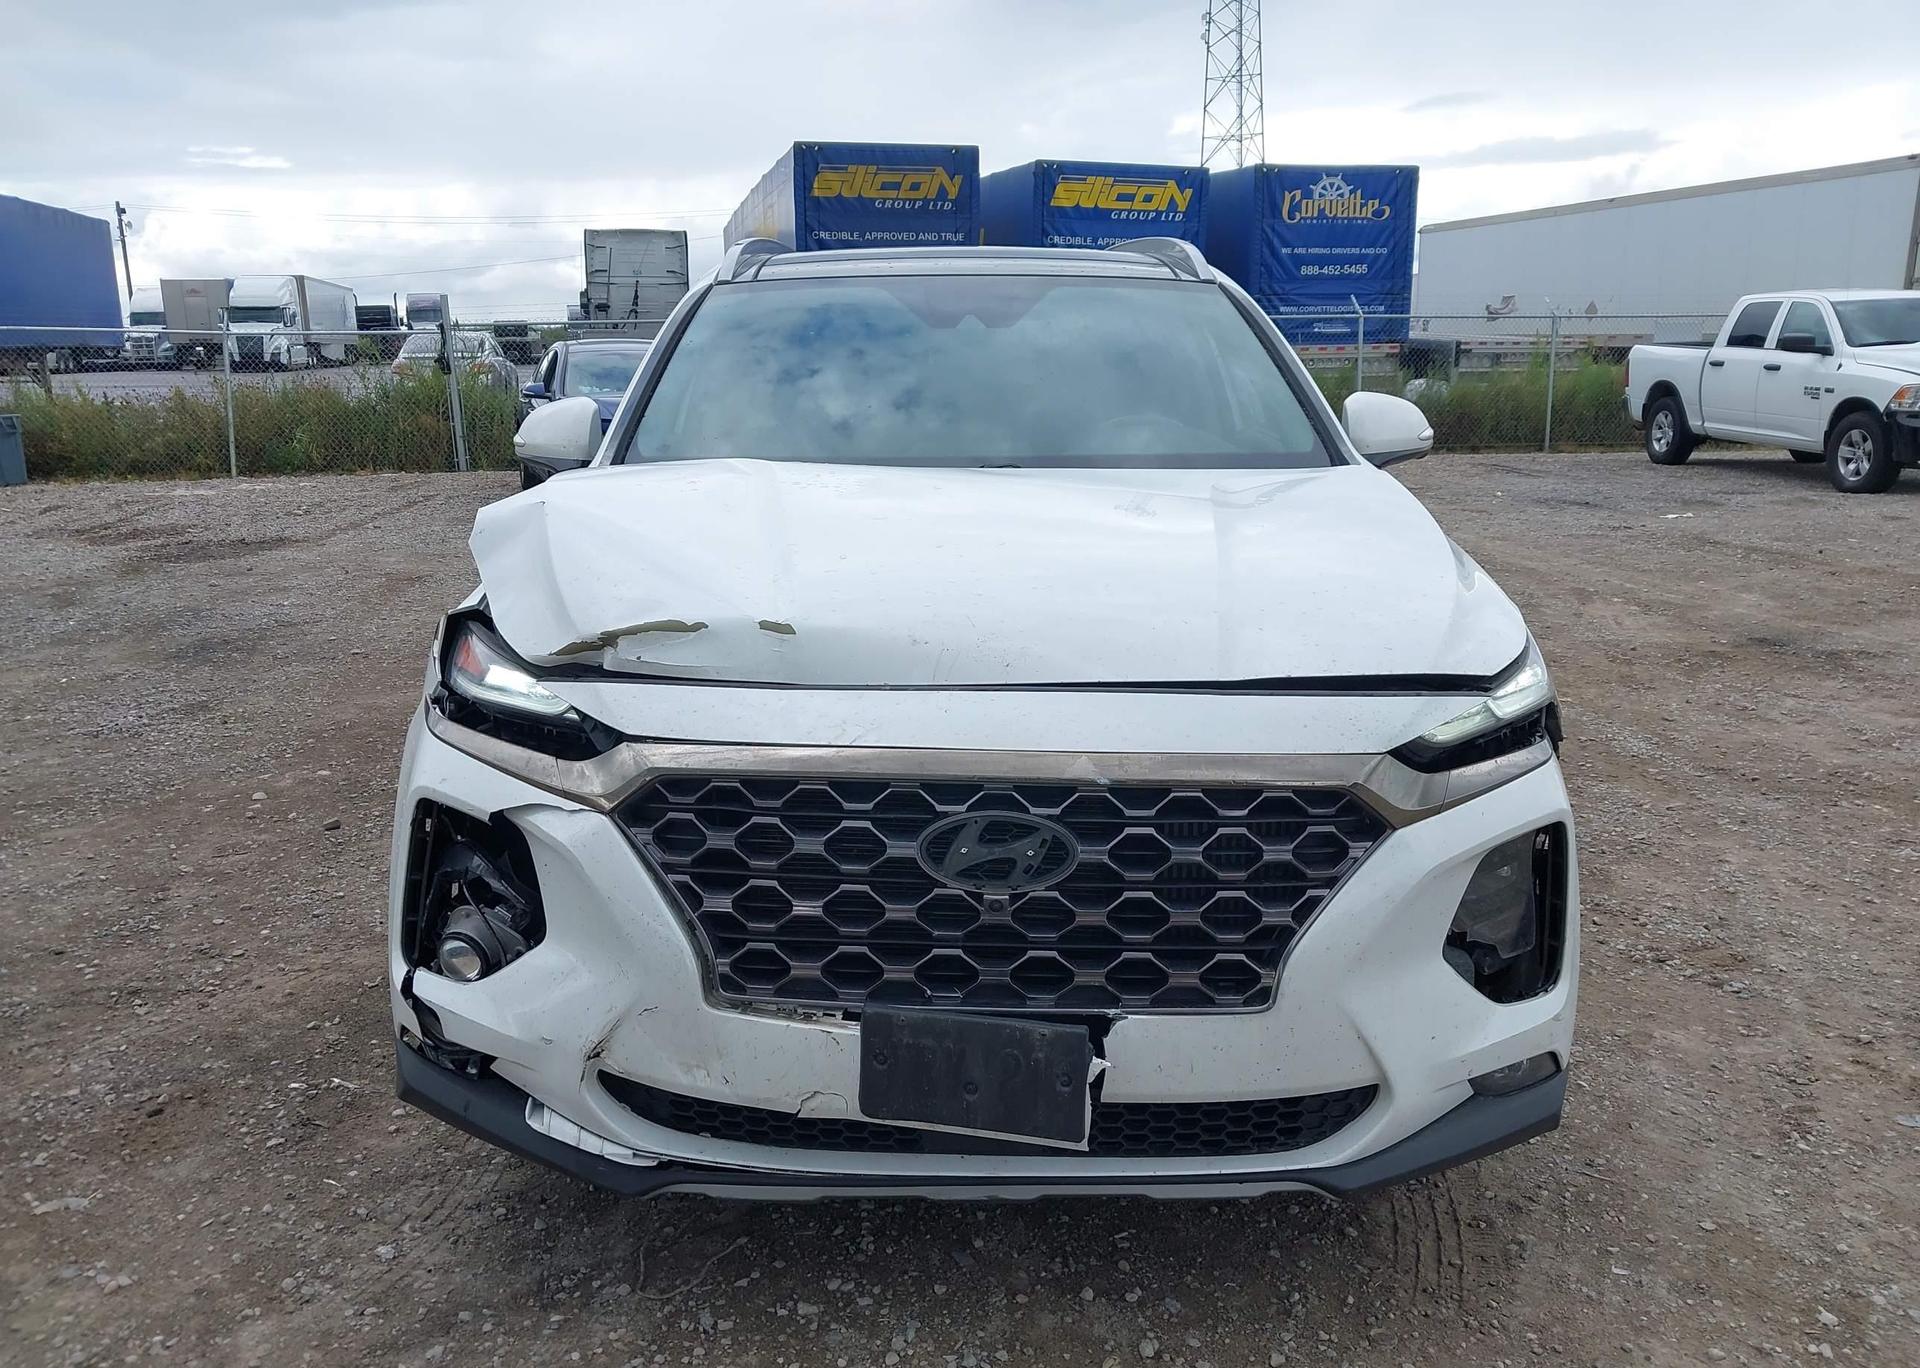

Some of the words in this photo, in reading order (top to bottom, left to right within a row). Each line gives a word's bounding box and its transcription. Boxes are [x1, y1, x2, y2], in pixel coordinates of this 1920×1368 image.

[875, 199, 923, 208] GROUP
[928, 201, 957, 210] LTD.
[1282, 190, 1391, 223] Corvette
[1111, 211, 1156, 220] GROUP
[1161, 212, 1186, 222] LTD.
[812, 231, 863, 241] CREDIBLE,
[865, 231, 916, 241] APPROVED
[918, 232, 939, 241] AND
[940, 232, 965, 241] TRUE
[1047, 235, 1095, 246] CREDIBLE,
[1300, 264, 1368, 275] 888-452-5455
